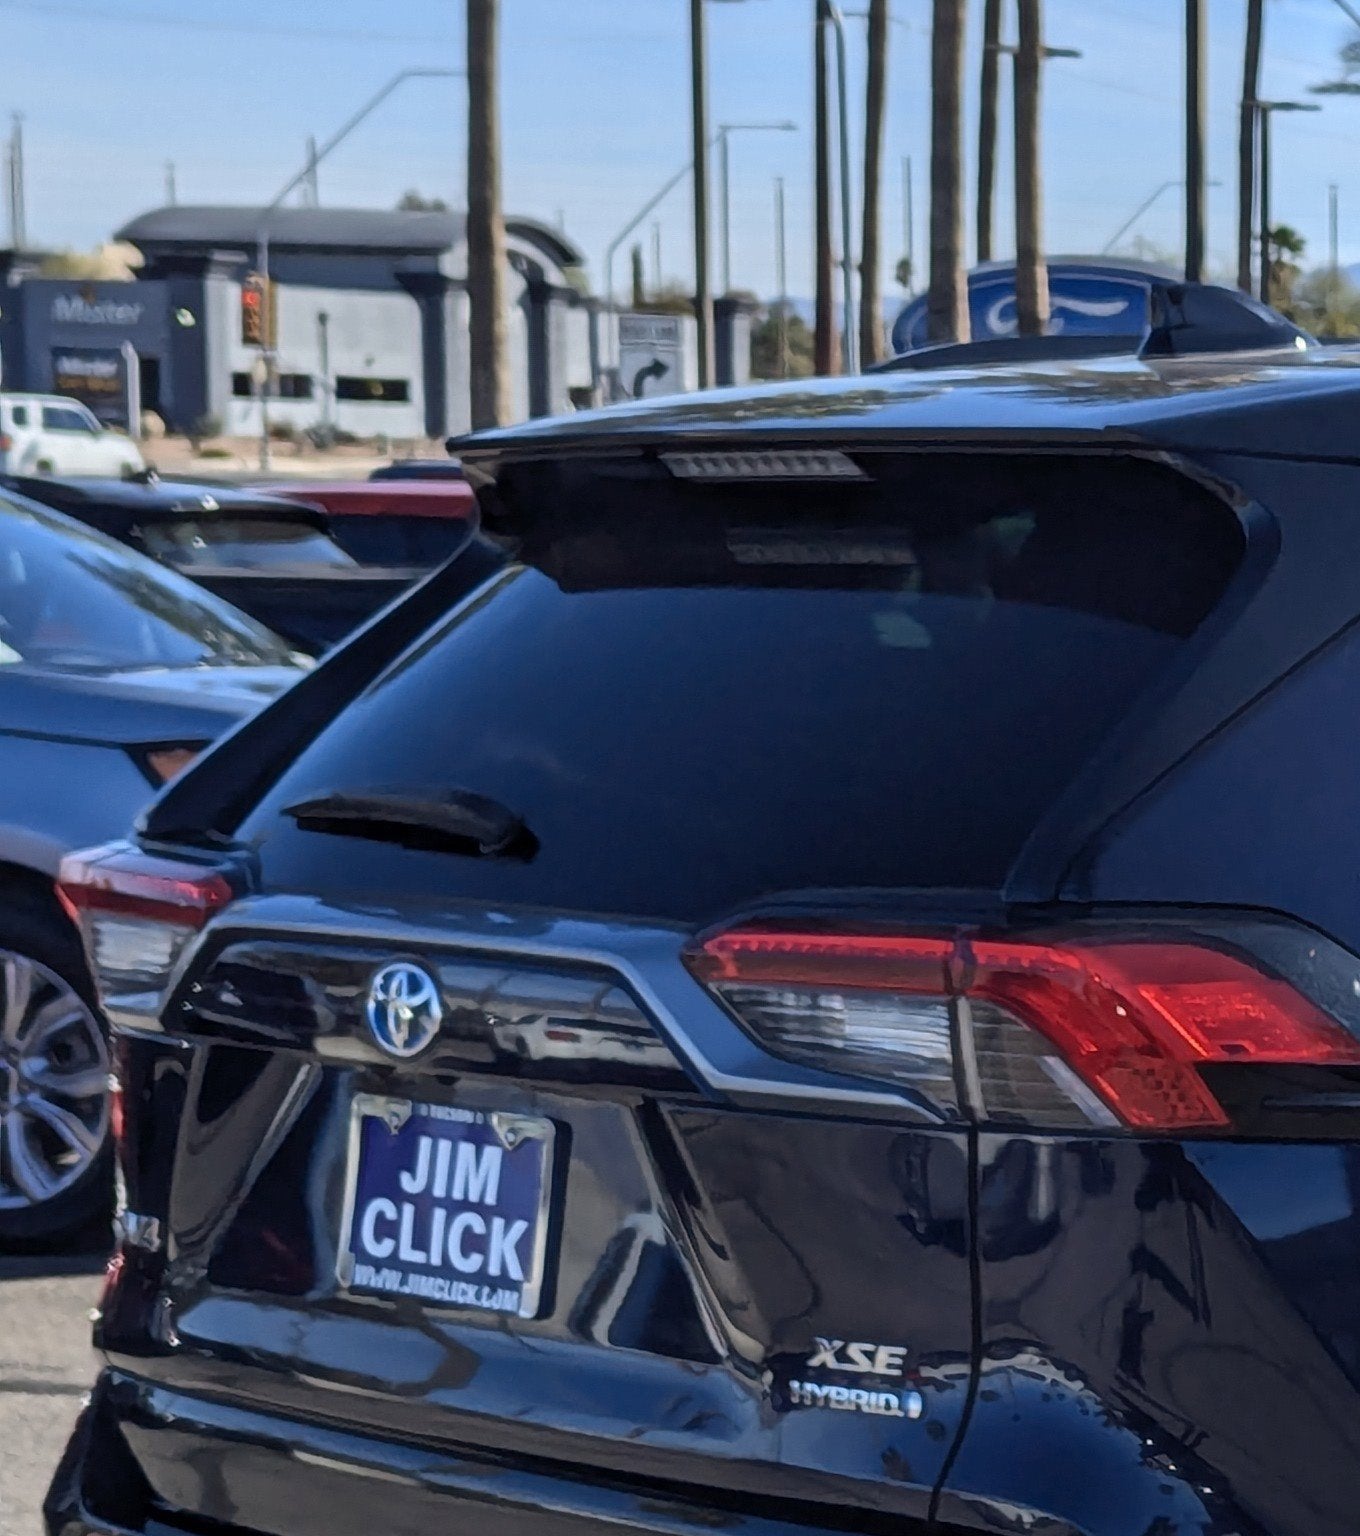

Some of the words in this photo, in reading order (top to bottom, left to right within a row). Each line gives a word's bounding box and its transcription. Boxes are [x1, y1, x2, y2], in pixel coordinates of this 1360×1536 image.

[400, 1135, 503, 1206] JIM
[361, 1197, 529, 1282] CLICK
[806, 1336, 908, 1376] XSE
[788, 1379, 905, 1418] HYBRID
